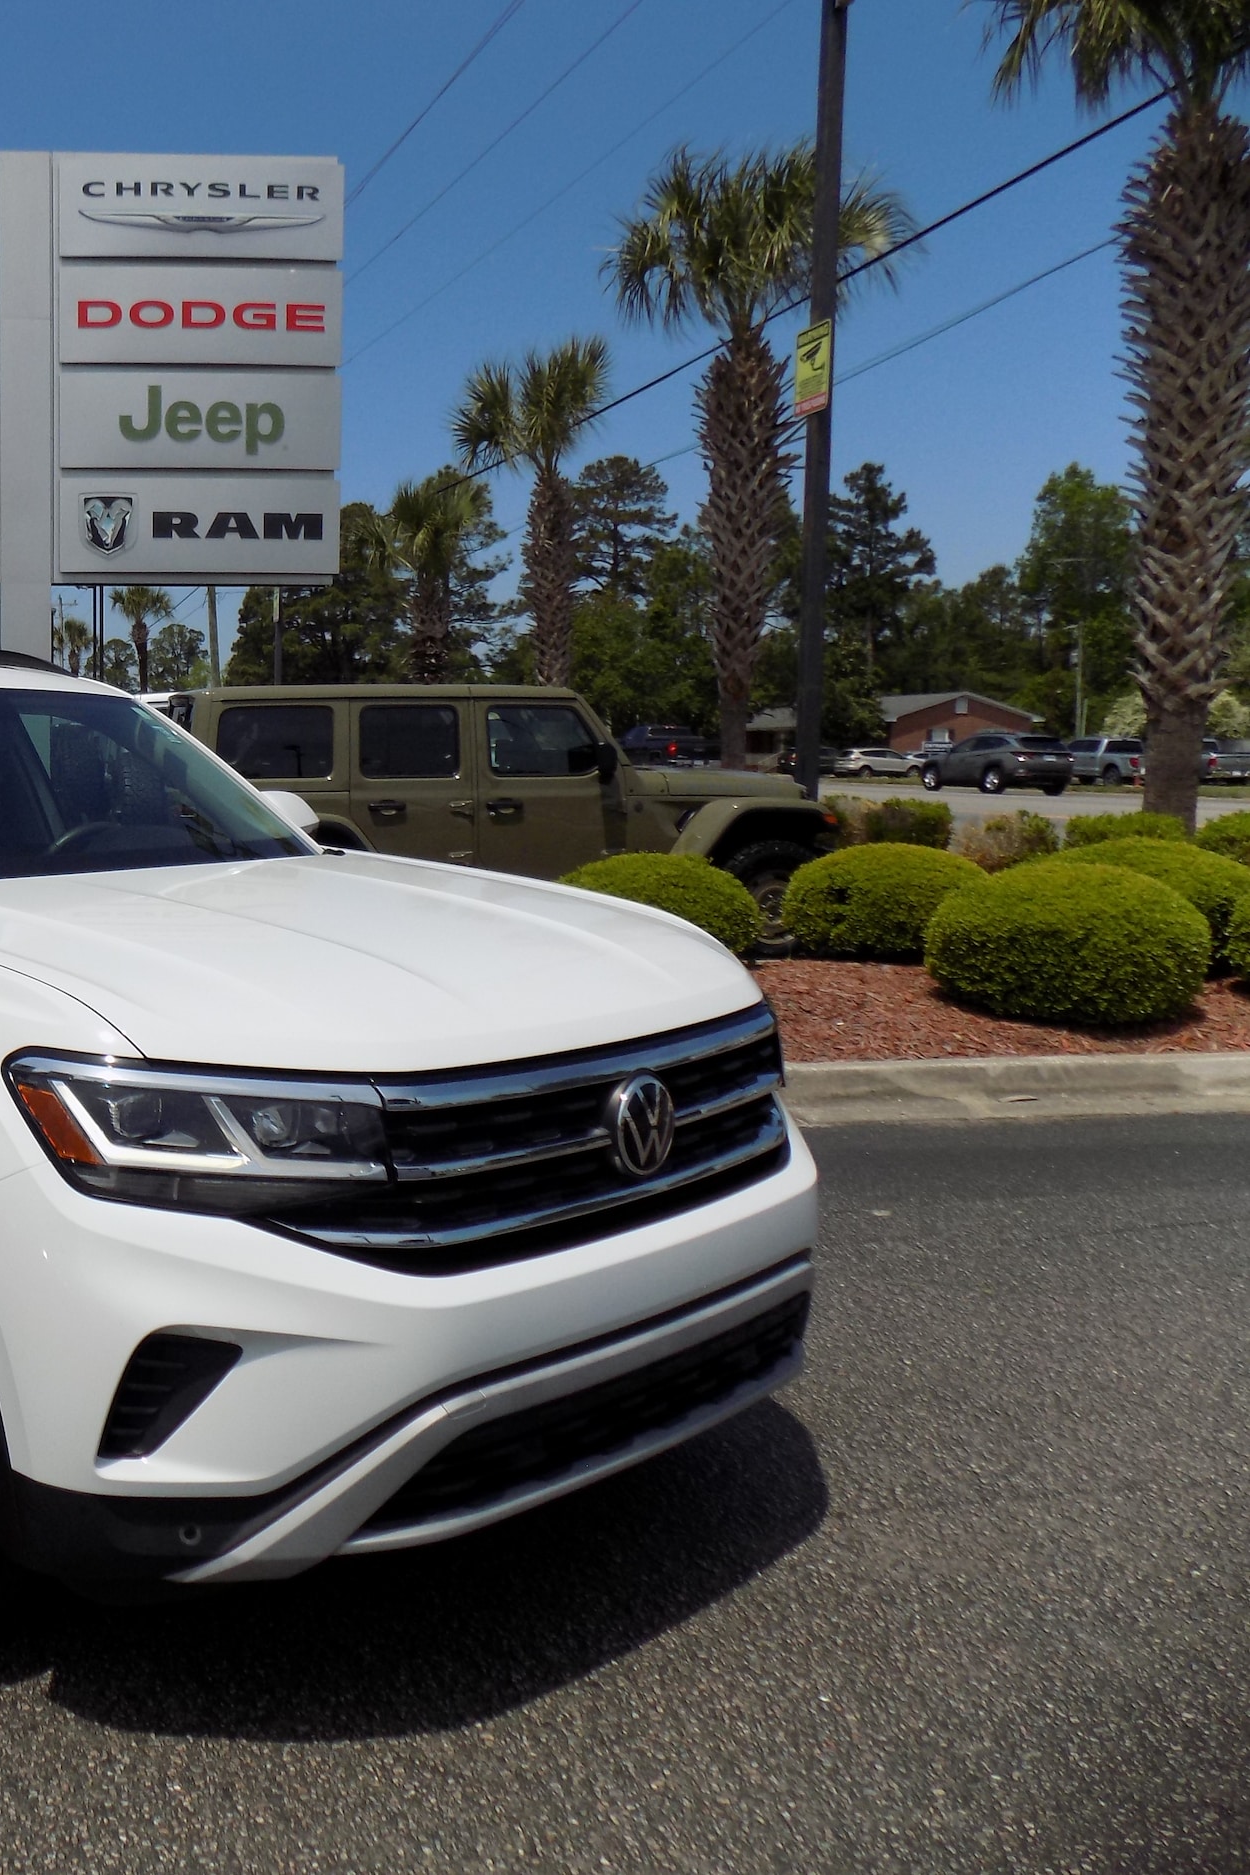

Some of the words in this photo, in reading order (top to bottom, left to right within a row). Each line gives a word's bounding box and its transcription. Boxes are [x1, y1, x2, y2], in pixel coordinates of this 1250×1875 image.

[82, 181, 320, 202] CHRYSLER
[77, 299, 326, 332] DODGE
[118, 385, 285, 455] Jeep
[152, 511, 324, 541] RAM
